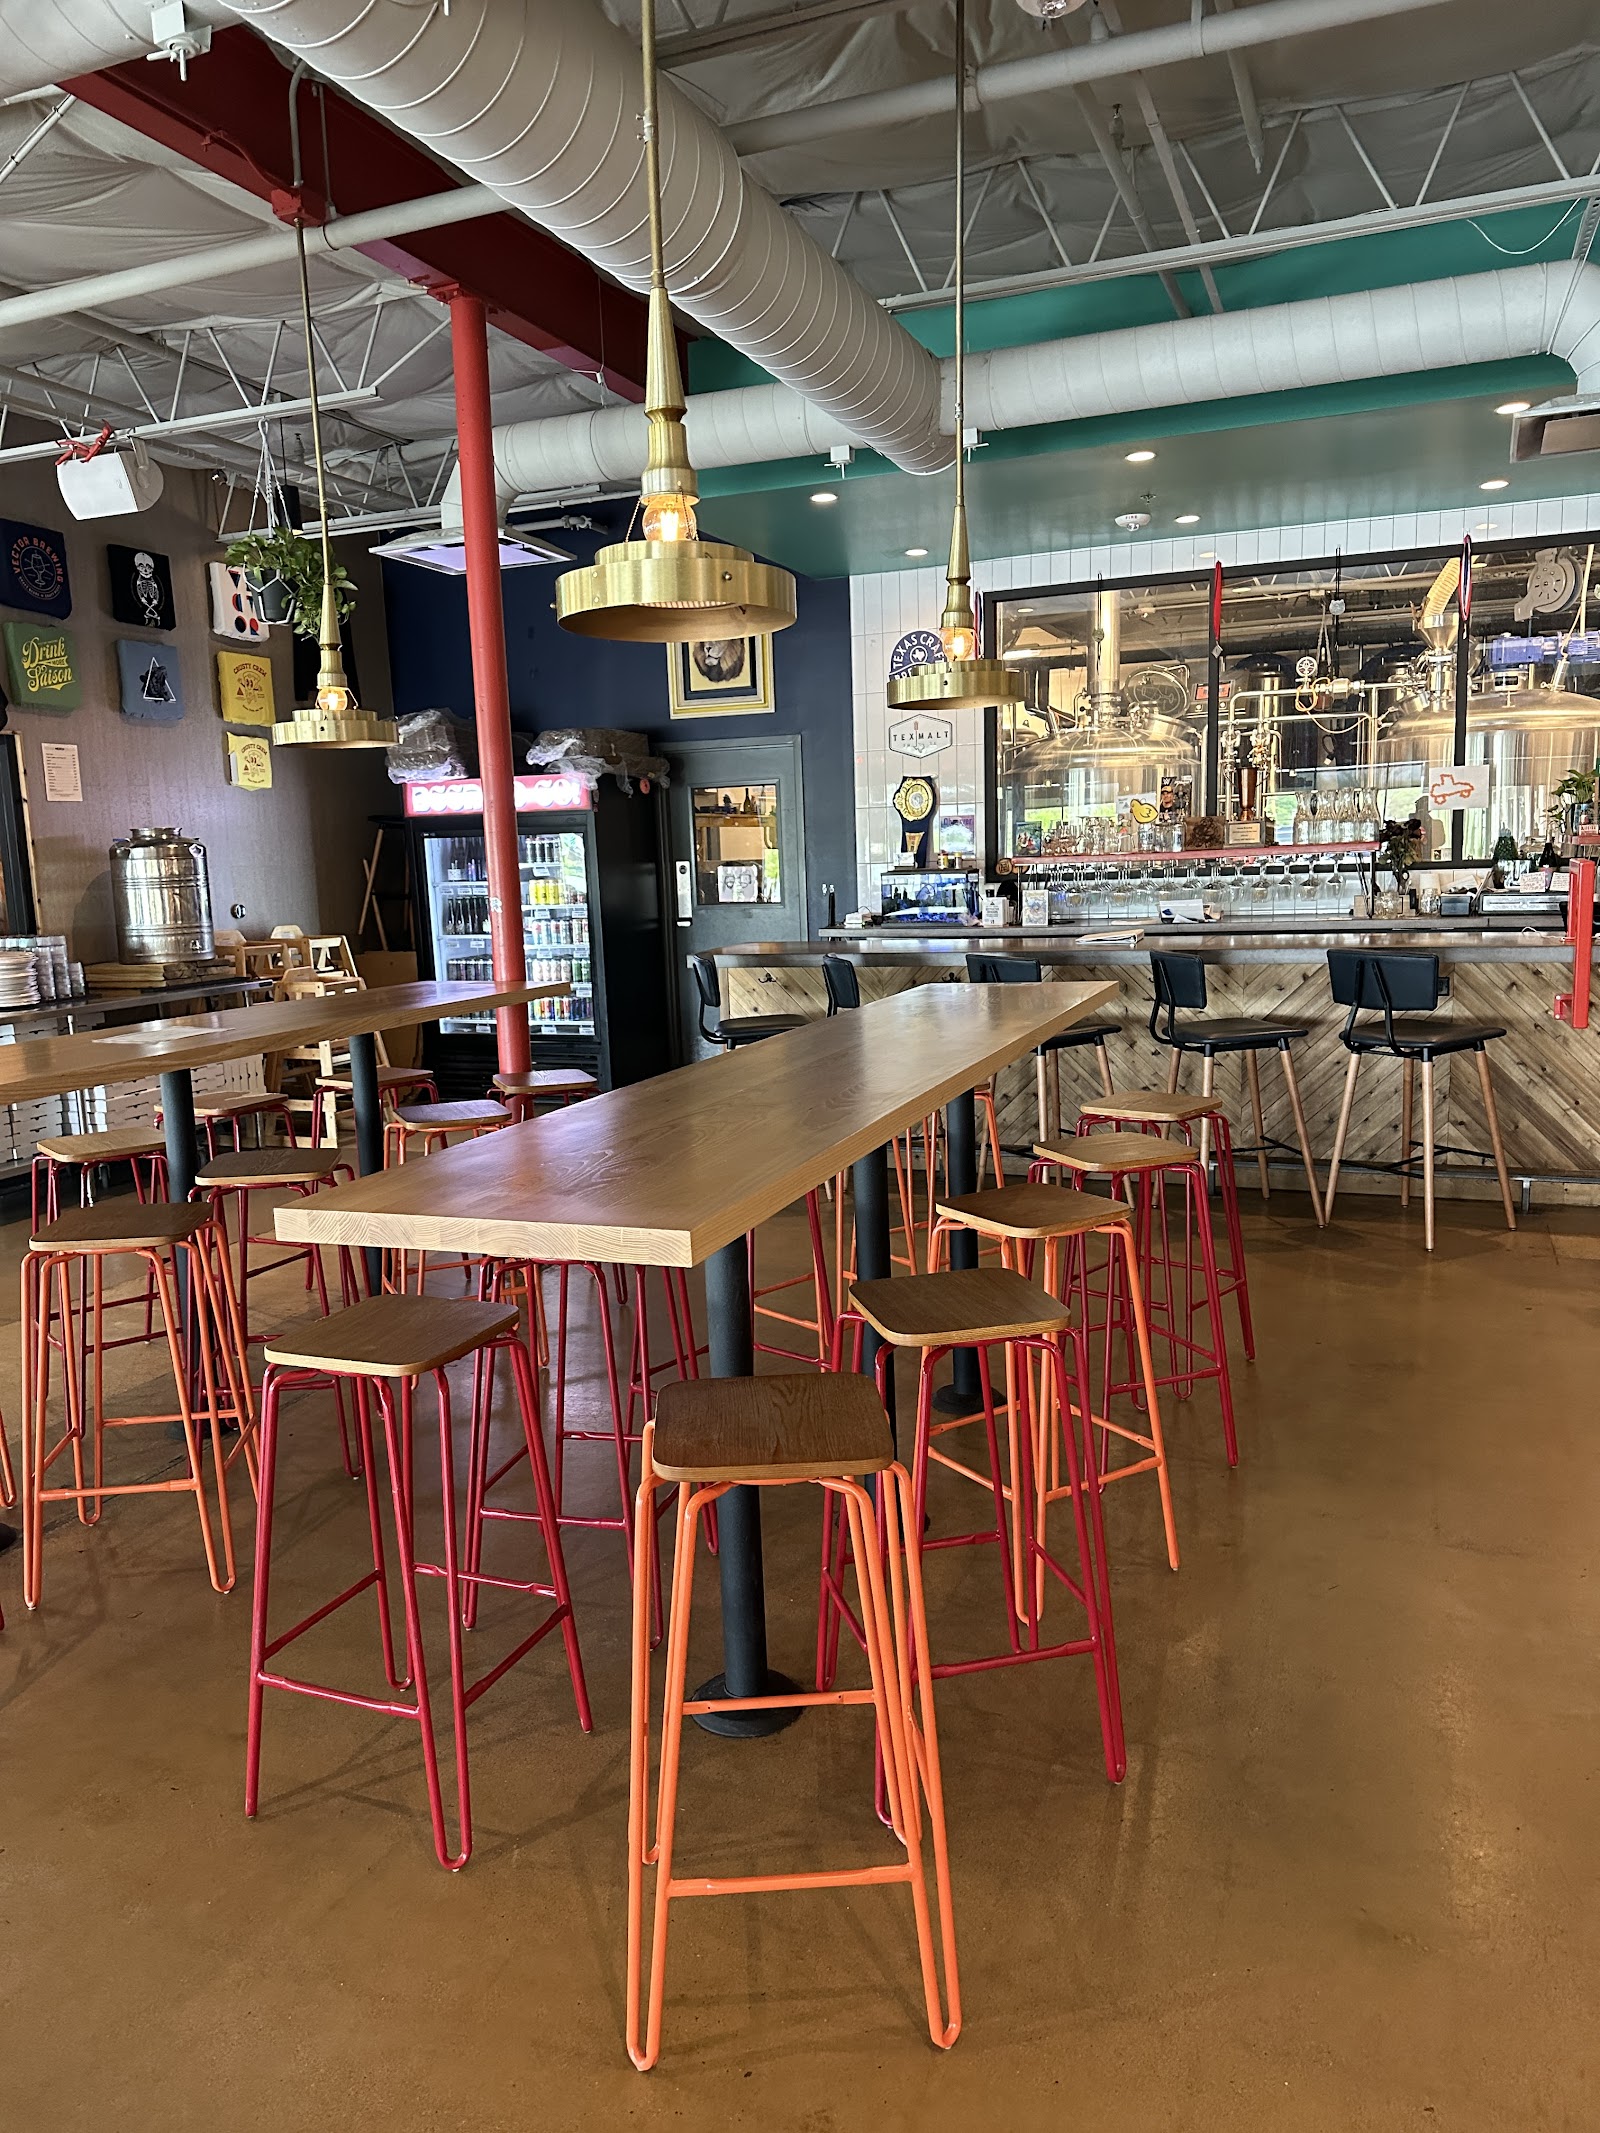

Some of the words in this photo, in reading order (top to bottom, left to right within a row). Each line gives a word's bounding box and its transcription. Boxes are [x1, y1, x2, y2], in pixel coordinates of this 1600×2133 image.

[11, 536, 30, 574] VECTOR
[32, 537, 64, 583] BREWING
[22, 637, 65, 669] Drink
[893, 634, 918, 669] TEXAS
[920, 633, 945, 663] CRAFT
[27, 665, 72, 692] Saison
[233, 662, 251, 674] CRUSTY
